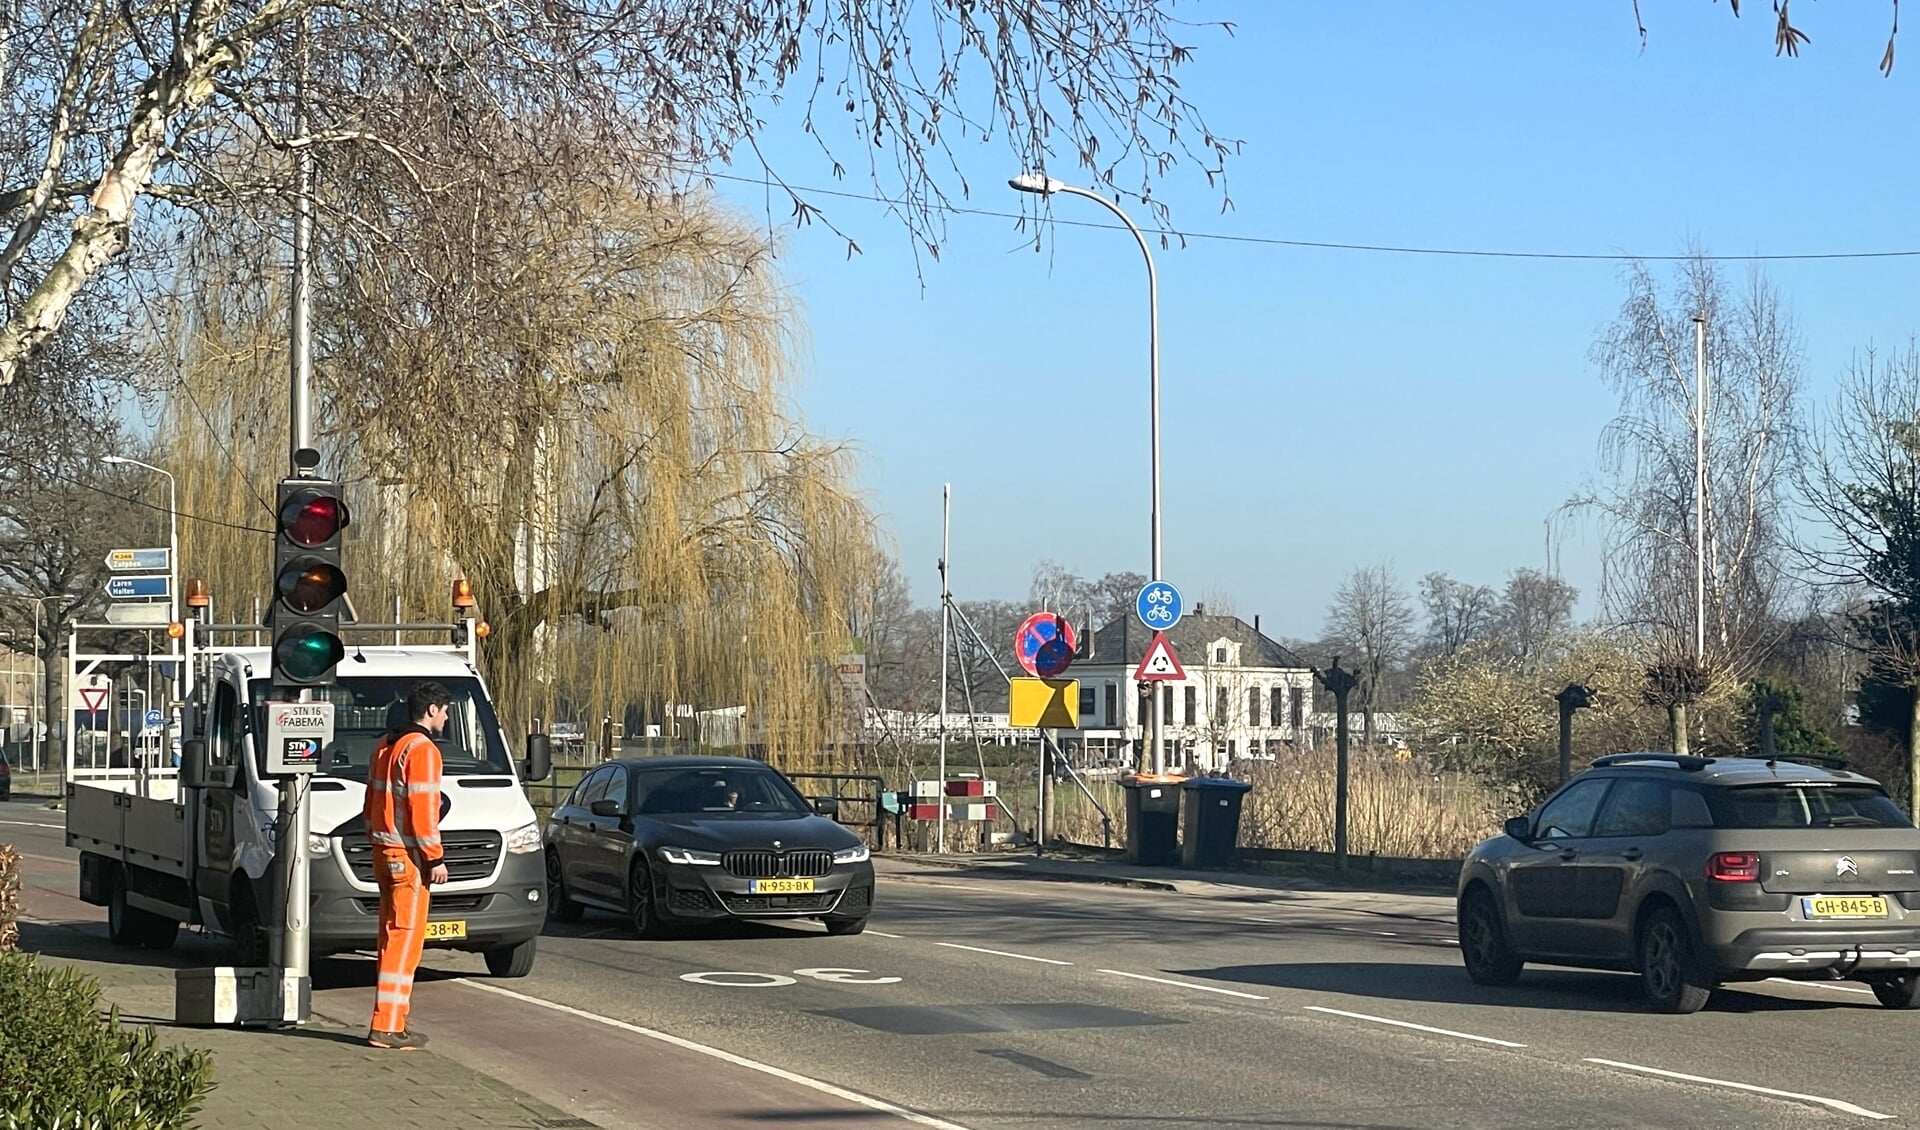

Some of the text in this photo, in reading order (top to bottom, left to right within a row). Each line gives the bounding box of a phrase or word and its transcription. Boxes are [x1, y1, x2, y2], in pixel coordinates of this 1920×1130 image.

[293, 706, 321, 715] STN 16
[283, 717, 325, 727] FABEMA
[288, 741, 307, 750] STN
[759, 881, 810, 892] N-953-BK
[1815, 900, 1883, 913] GH-845-B
